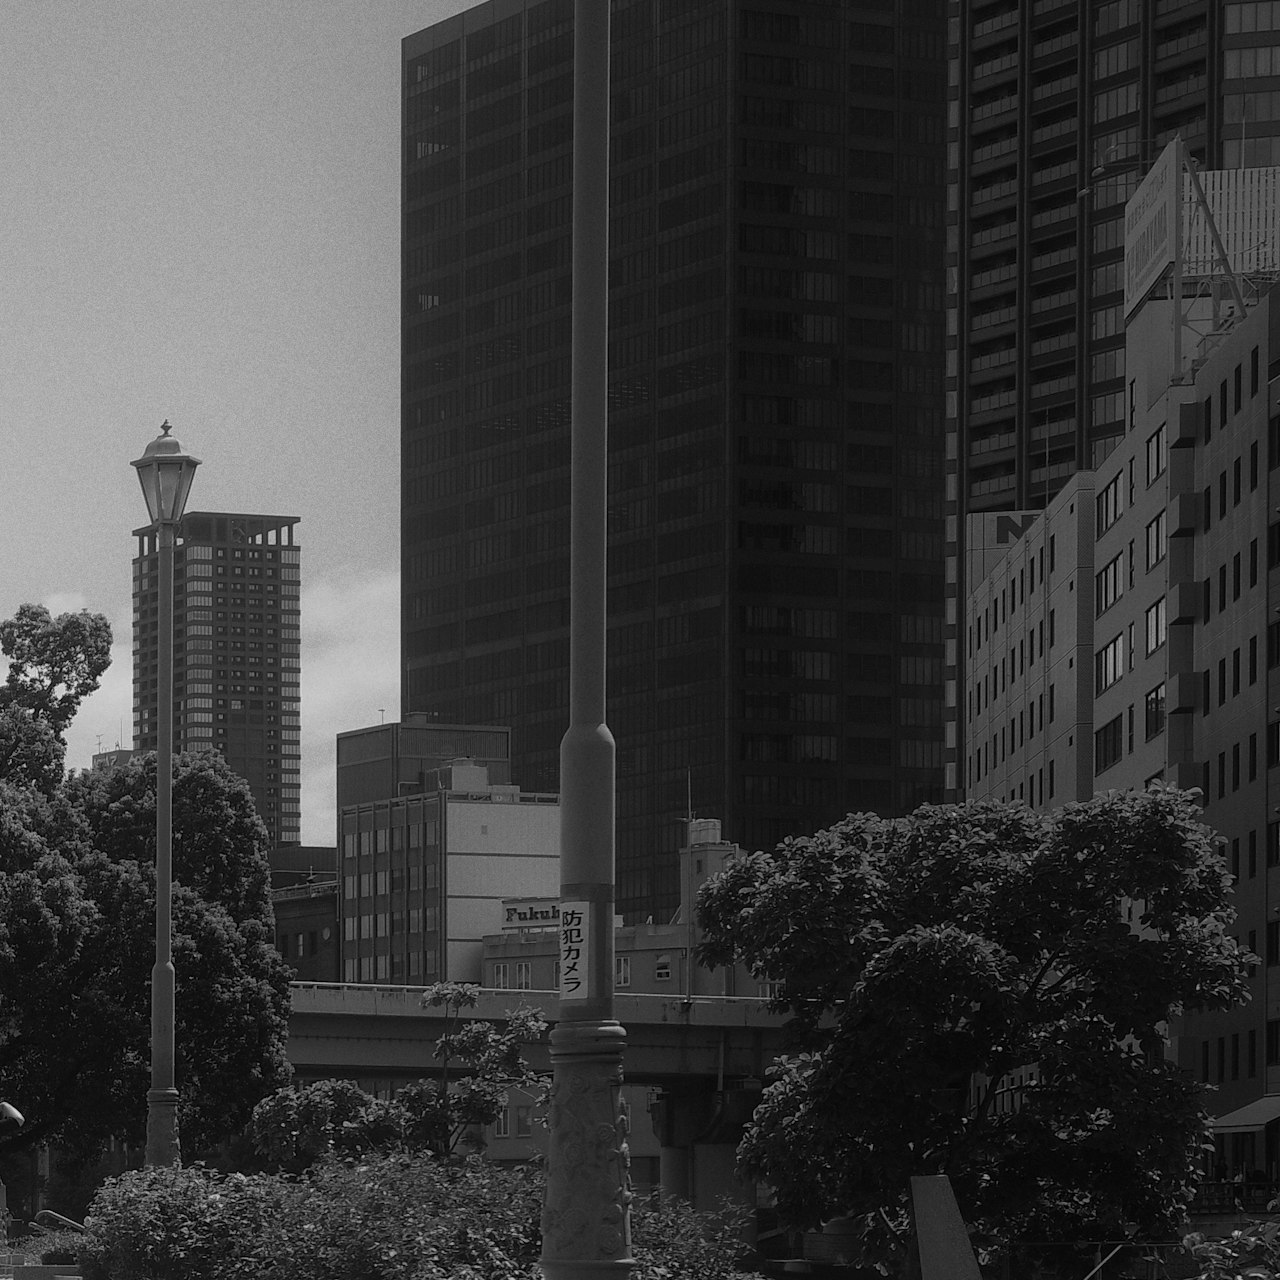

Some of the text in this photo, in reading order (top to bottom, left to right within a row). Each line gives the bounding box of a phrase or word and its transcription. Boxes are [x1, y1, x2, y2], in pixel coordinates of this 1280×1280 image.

[562, 910, 584, 992] 防犯カメラ
